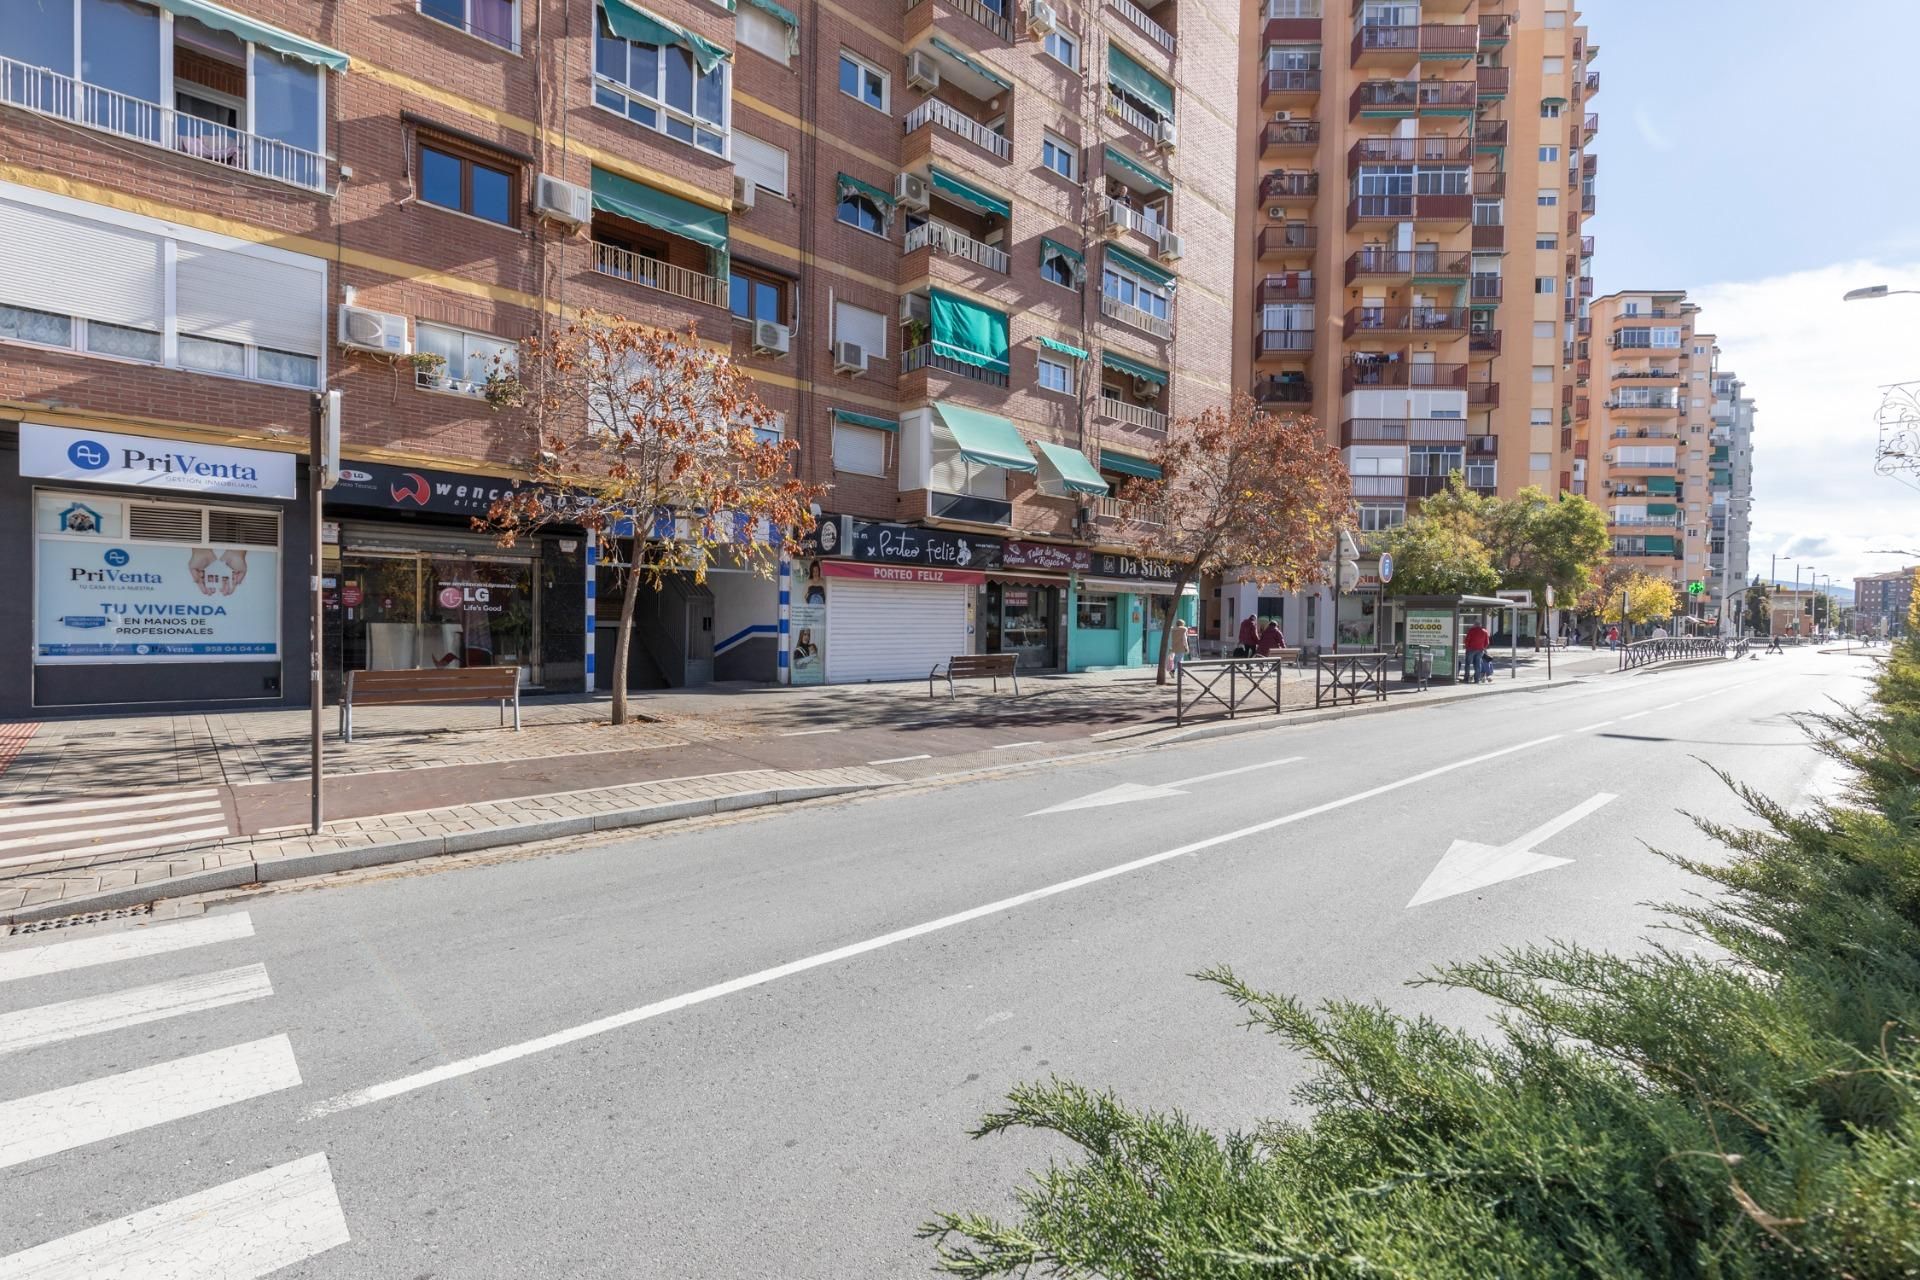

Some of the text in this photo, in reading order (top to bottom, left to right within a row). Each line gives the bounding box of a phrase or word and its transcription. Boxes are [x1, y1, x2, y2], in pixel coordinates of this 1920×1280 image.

[122, 449, 258, 481] PriVenta
[165, 475, 258, 489] GESTIÓN INMOBILIARIA
[880, 530, 956, 563] Porteo Feliz
[873, 567, 944, 582] PORTEO FELIZ
[1120, 557, 1137, 575] Da
[1141, 557, 1172, 578] Silva
[70, 567, 163, 584] PriVenta
[463, 587, 490, 602] LG
[100, 603, 227, 616] TU VIVIENDA
[483, 604, 502, 612] Good
[124, 617, 140, 625] EN
[144, 617, 188, 625] MANOS
[116, 627, 214, 635] PROFESIONALES
